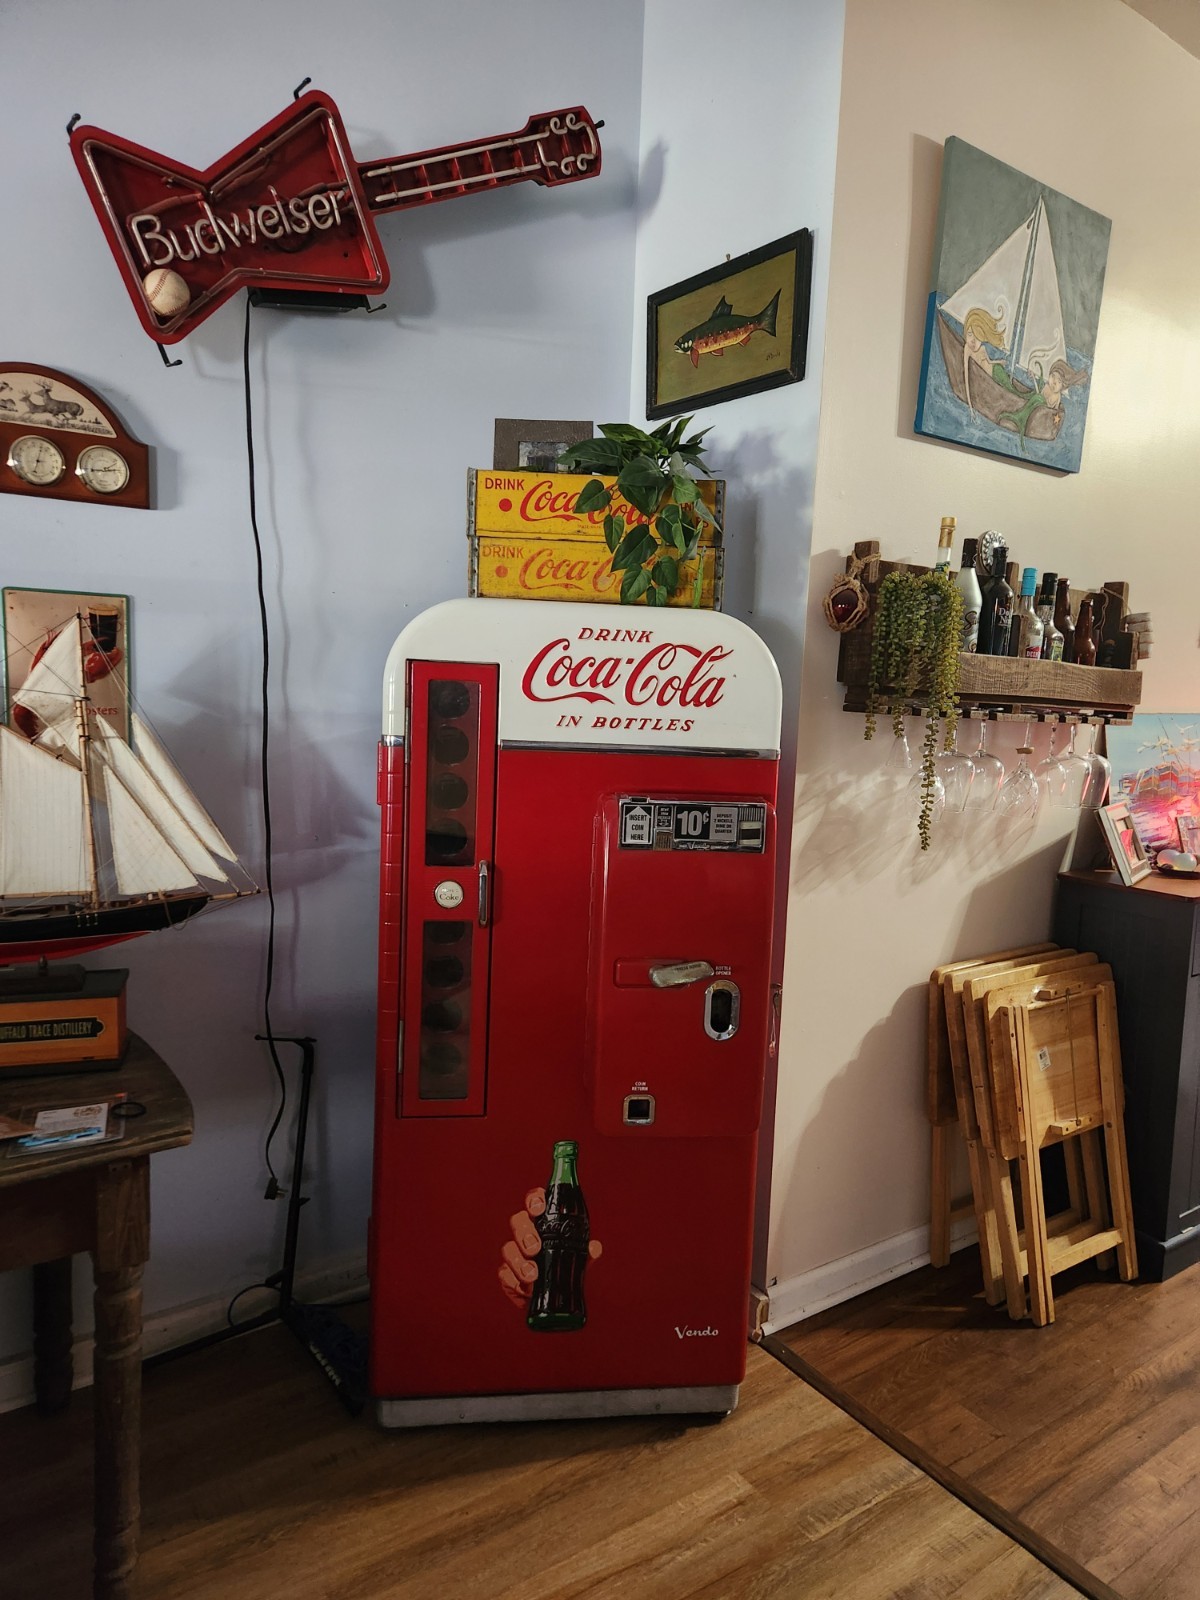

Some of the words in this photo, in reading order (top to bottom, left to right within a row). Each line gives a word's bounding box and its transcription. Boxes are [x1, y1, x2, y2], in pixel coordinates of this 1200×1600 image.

[131, 185, 346, 266] Budweiser
[485, 478, 525, 491] DRINK
[482, 546, 524, 558] DRINK
[578, 627, 654, 643] DRINK
[556, 715, 583, 727] IN
[591, 716, 695, 732] BOTTLES
[629, 814, 648, 822] INSERT
[440, 893, 459, 901] Coke
[28, 1024, 51, 1038] TRACE
[53, 1021, 93, 1036] DISTILLERY
[674, 1325, 719, 1339] Vendo
